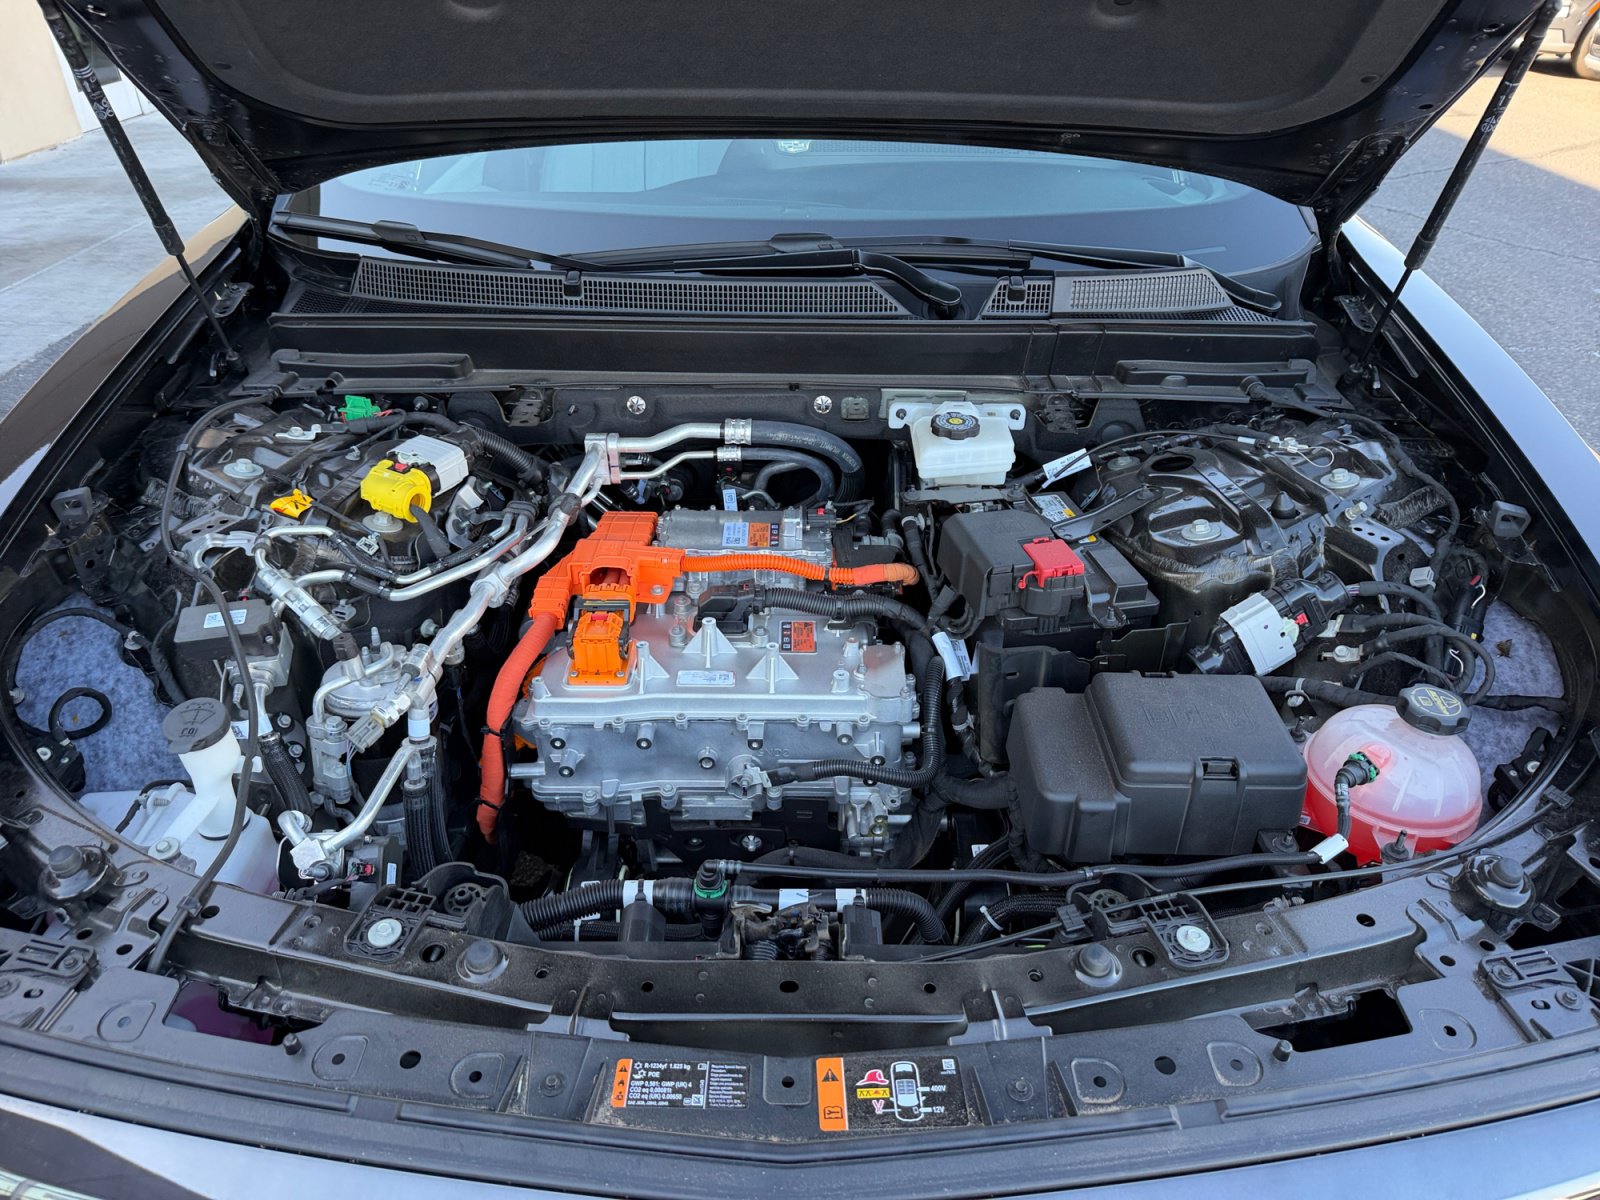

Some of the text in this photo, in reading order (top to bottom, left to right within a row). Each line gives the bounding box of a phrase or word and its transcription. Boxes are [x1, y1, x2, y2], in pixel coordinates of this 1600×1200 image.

[644, 1062, 668, 1070] R-1234yf
[683, 1063, 691, 1071] kg
[675, 1081, 688, 1089] (UK)
